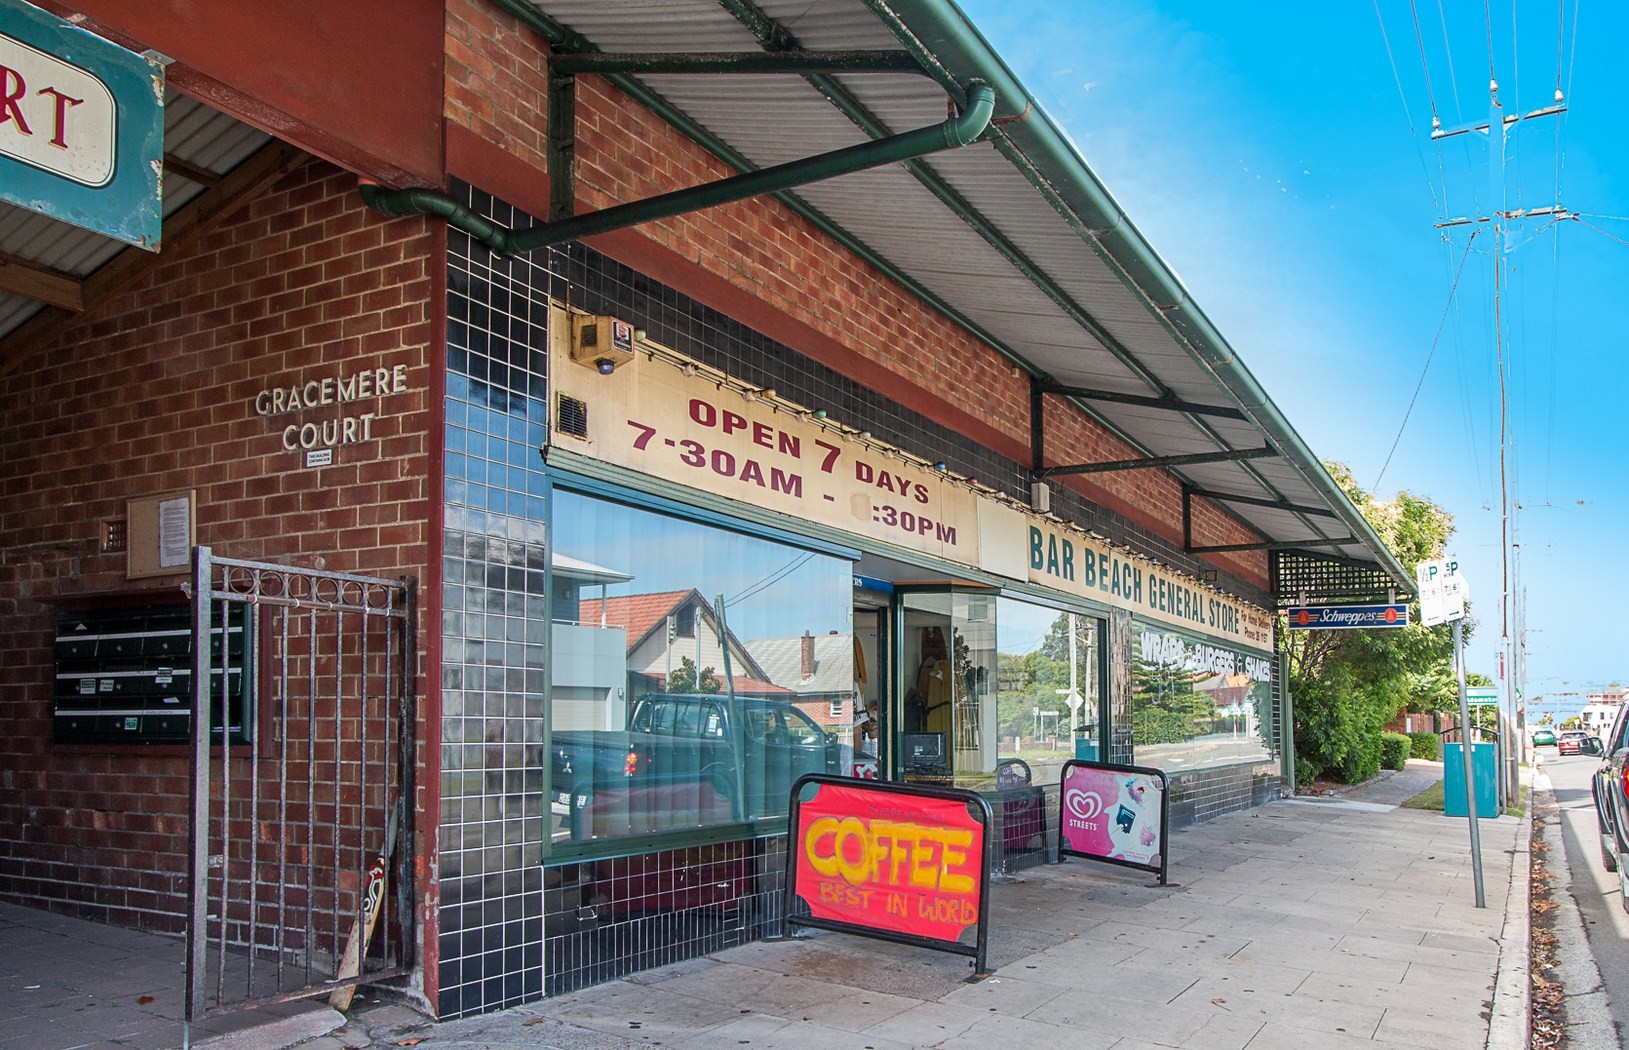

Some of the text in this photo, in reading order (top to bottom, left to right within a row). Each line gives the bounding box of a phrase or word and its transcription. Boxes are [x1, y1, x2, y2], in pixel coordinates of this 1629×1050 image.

[255, 364, 408, 415] GRACEMERE
[282, 412, 375, 450] COURT
[689, 399, 929, 504] OPEN 7 DAYS
[1030, 525, 1239, 634] BAR BEACH GENERAL STORE
[1319, 608, 1377, 625] Schweppes
[1140, 632, 1185, 669] WRAPS
[1194, 643, 1236, 676] BURGERS
[1069, 818, 1098, 832] STREETS
[805, 816, 976, 896] COFFEE
[820, 882, 876, 910] BEST
[886, 893, 908, 918] IN
